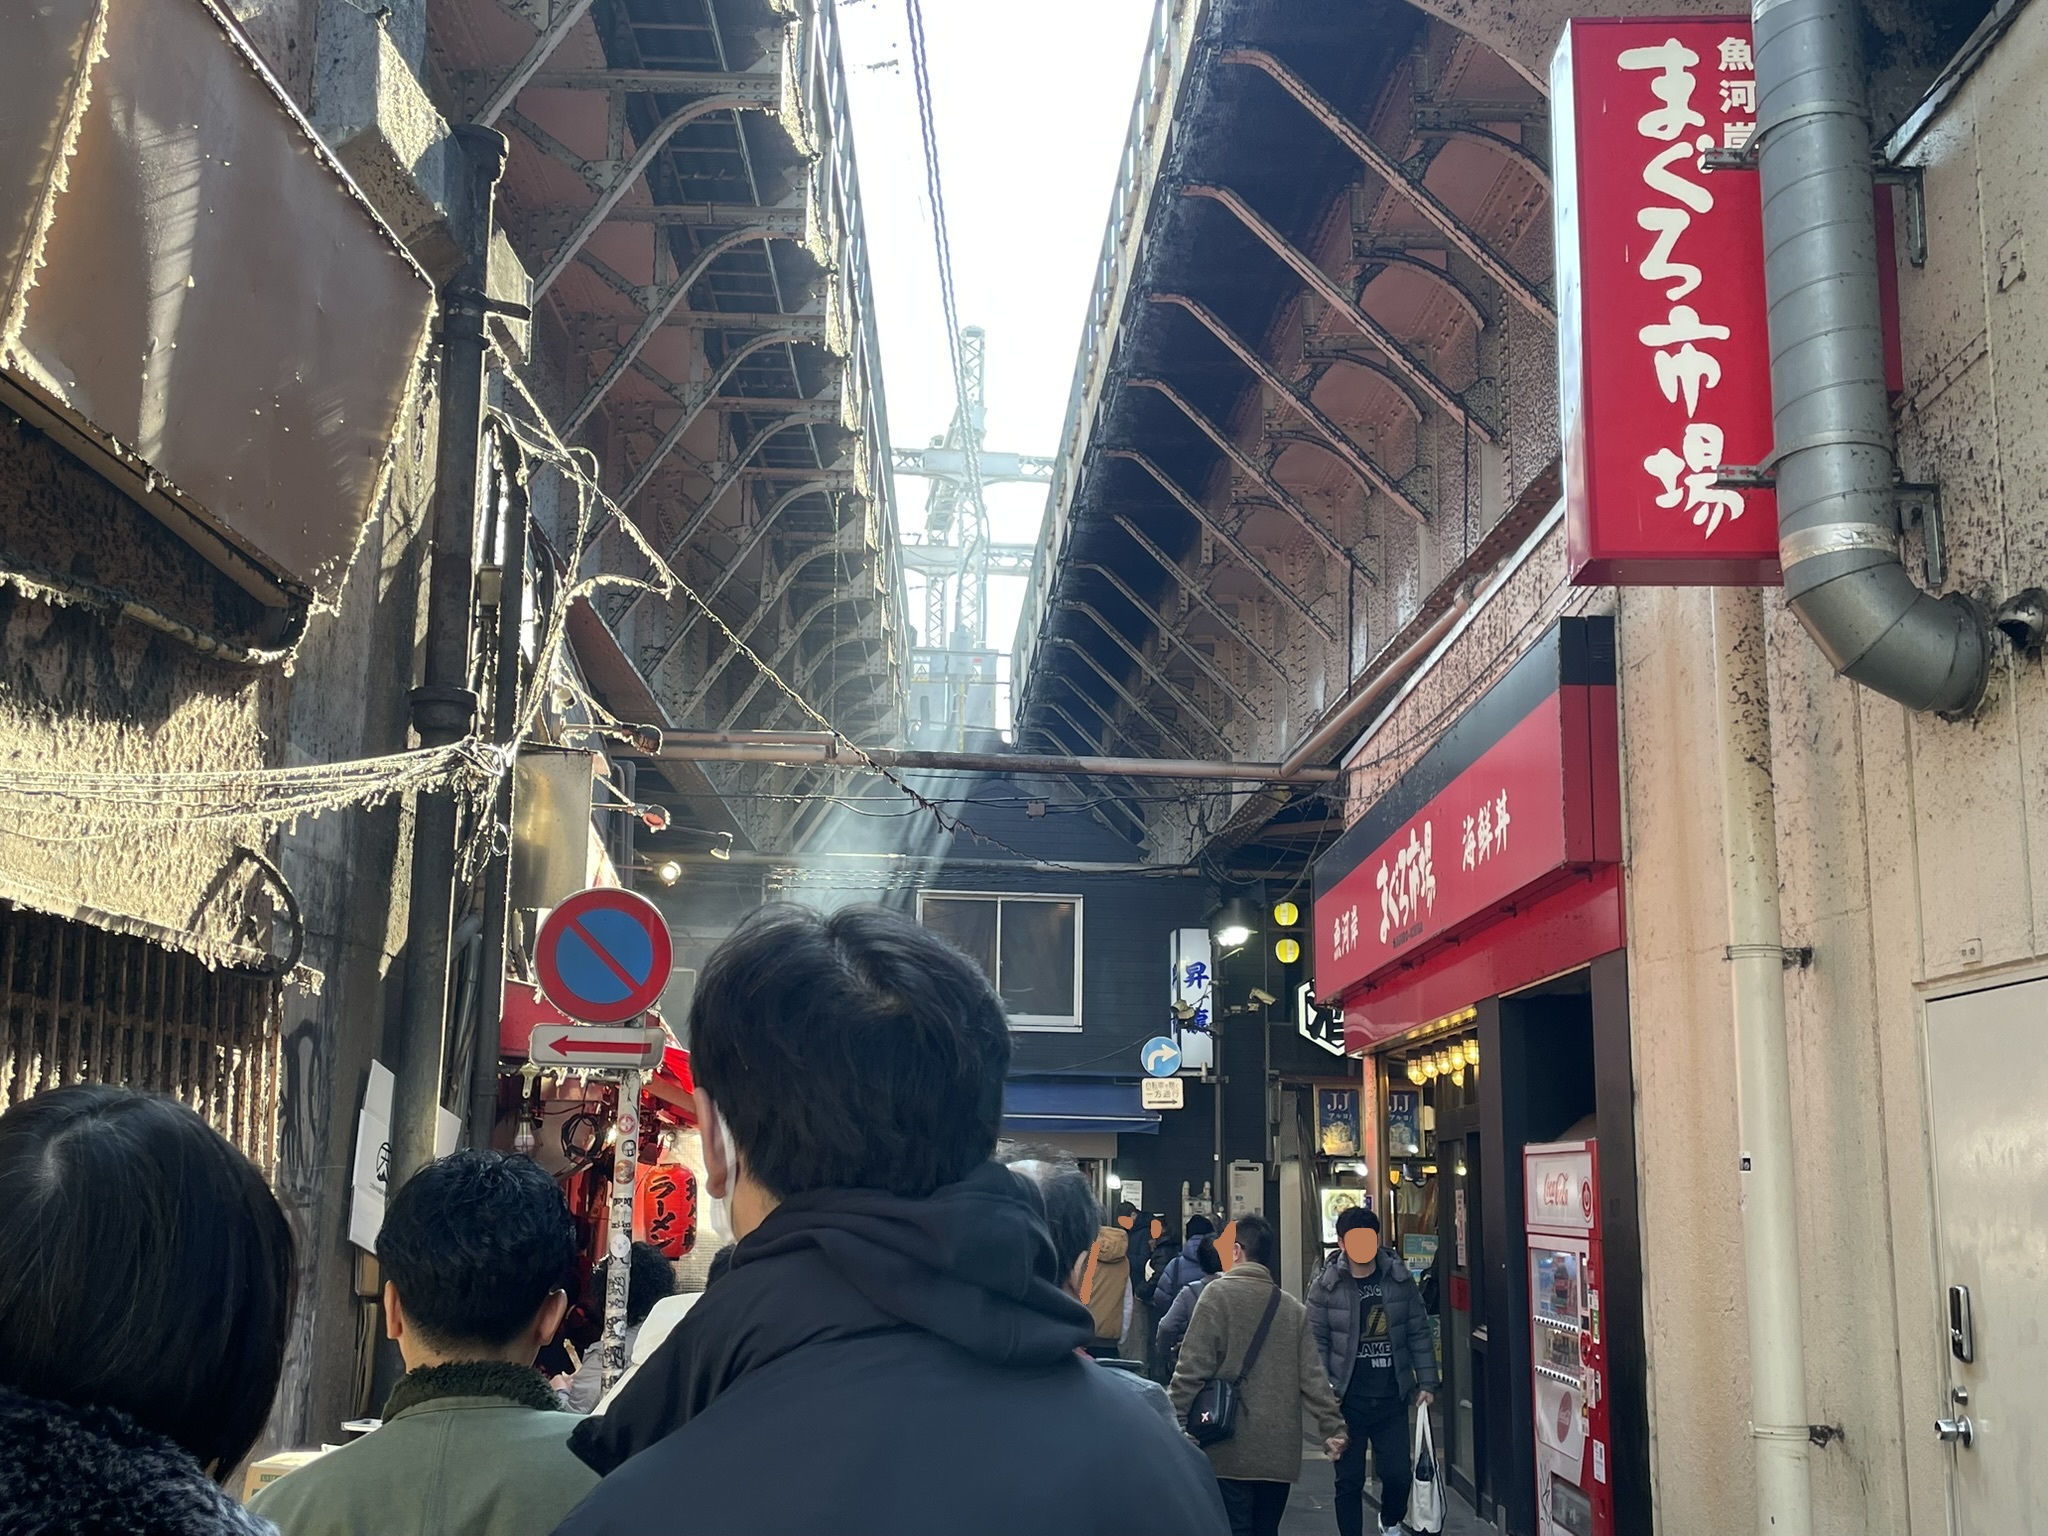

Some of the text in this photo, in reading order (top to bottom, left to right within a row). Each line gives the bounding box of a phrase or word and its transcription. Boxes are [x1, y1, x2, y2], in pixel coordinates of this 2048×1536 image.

[1617, 38, 1746, 540] まぐろ市場
[1377, 820, 1436, 944] まぐろ市場
[1462, 788, 1511, 872] 海鮮丼
[650, 1176, 676, 1250] ラーメン
